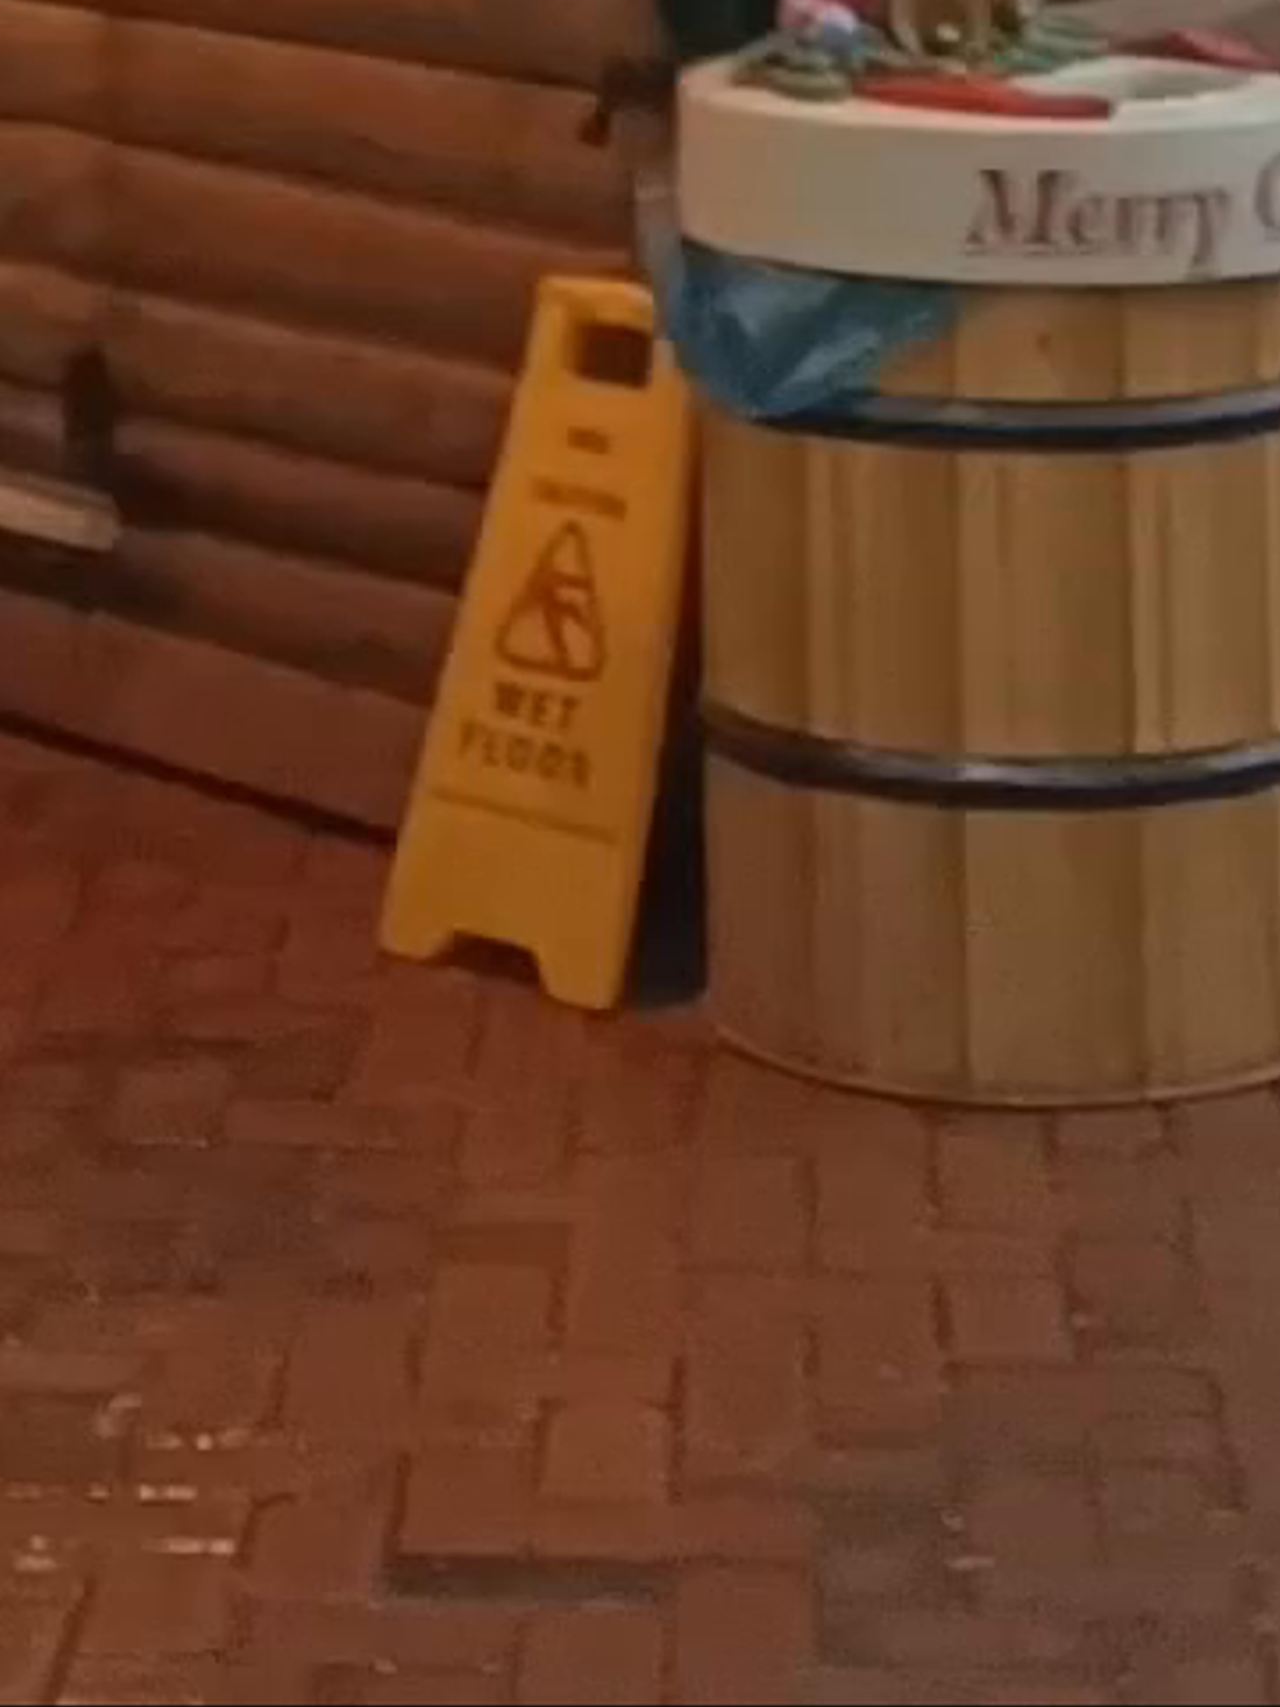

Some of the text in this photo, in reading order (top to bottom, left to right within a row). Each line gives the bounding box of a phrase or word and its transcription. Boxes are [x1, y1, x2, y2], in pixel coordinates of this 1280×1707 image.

[964, 166, 1233, 280] Merry
[493, 679, 581, 732] WET
[457, 717, 592, 792] FLOOR
